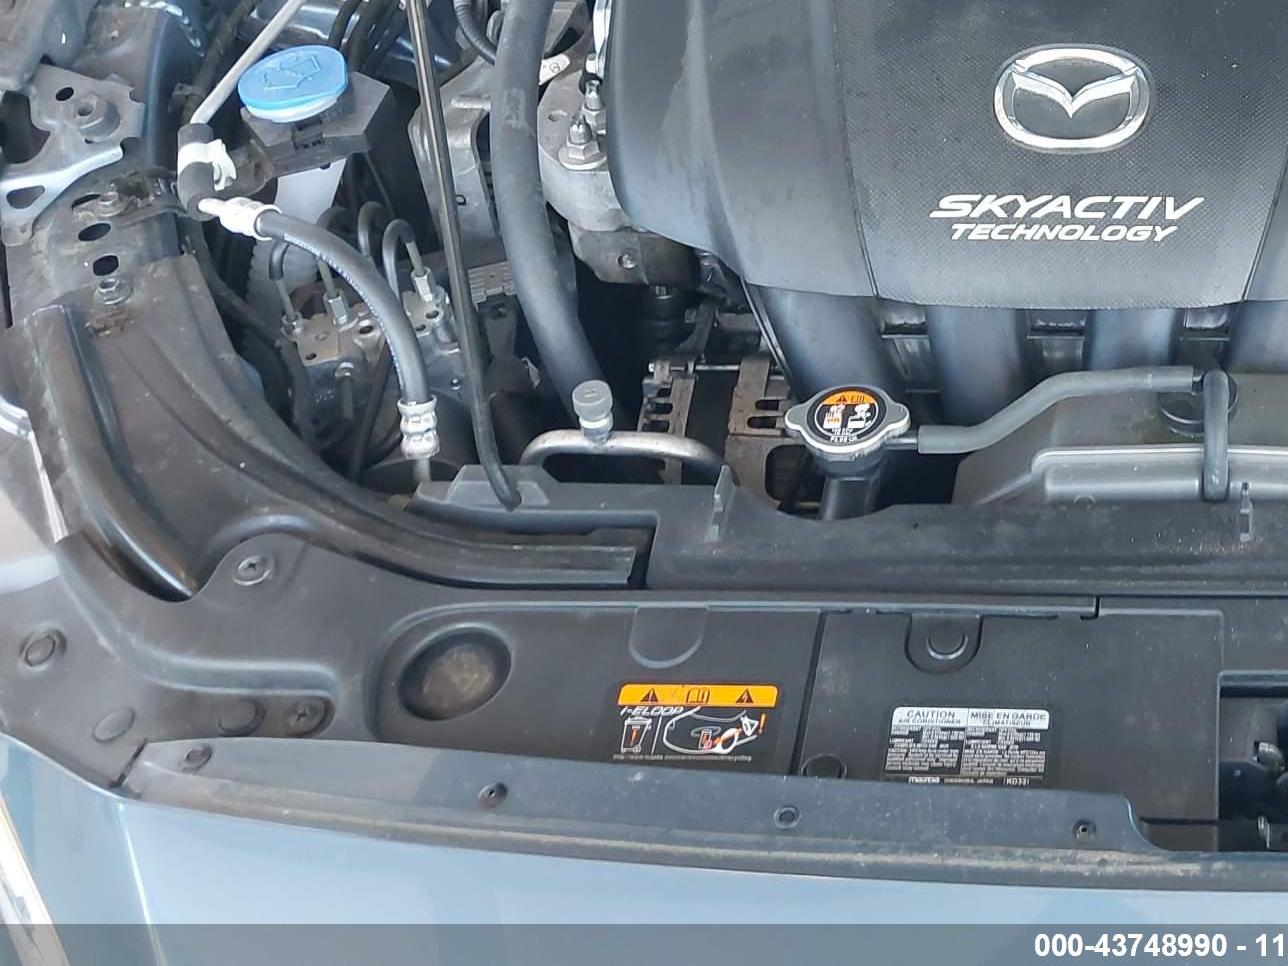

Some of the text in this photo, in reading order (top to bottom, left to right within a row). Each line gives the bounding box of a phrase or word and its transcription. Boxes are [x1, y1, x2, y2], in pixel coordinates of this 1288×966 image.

[929, 194, 1205, 220] SKYACTIV
[951, 222, 1178, 242] TECHNOLOGY
[907, 709, 956, 719] CAUTION
[996, 712, 1010, 720] EN
[1011, 712, 1047, 721] GARDE
